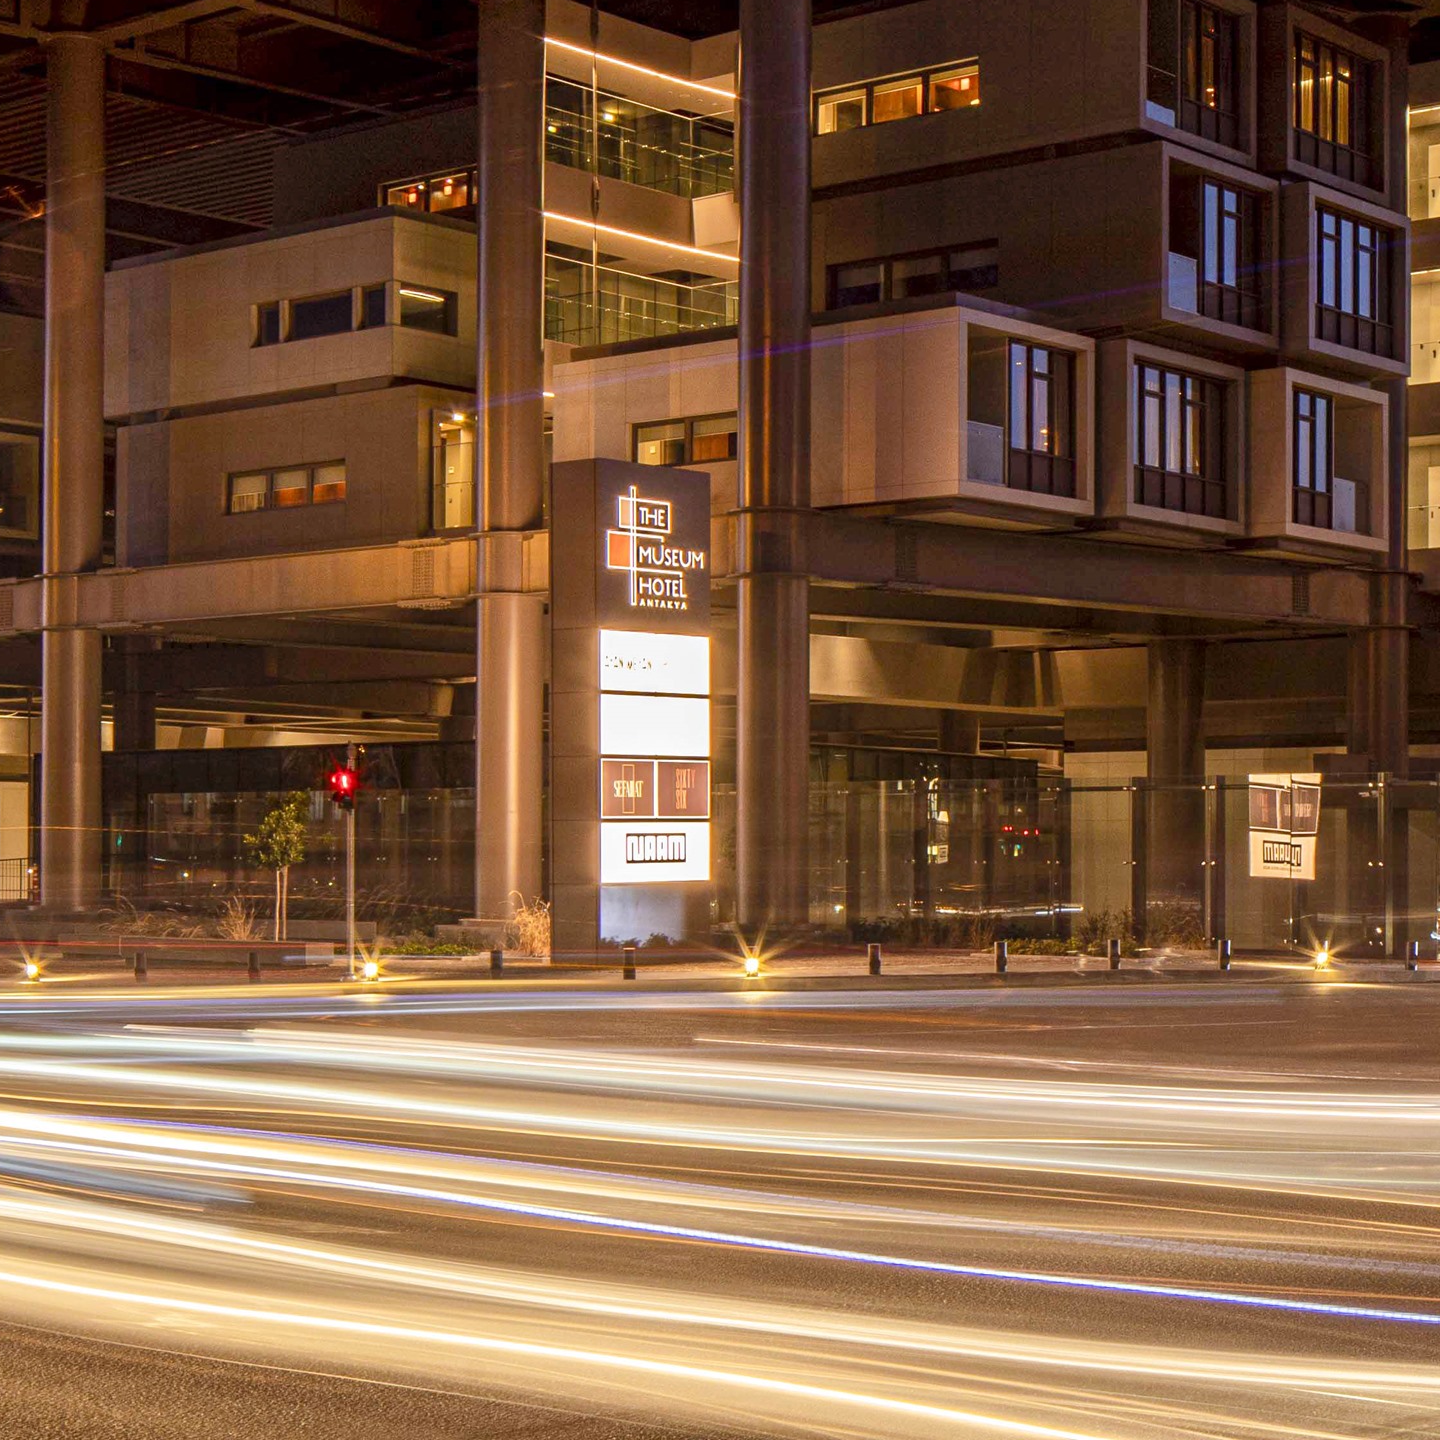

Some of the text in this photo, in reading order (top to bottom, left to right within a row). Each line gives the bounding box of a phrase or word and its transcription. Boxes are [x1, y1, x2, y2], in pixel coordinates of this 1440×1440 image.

[639, 507, 666, 527] THE
[639, 545, 704, 569] MUSEUM
[639, 577, 688, 598] HOTEL
[639, 598, 688, 610] ANTAKYA
[675, 768, 696, 789] SIXTY
[675, 789, 687, 810] SIX
[626, 833, 686, 863] NAAM
